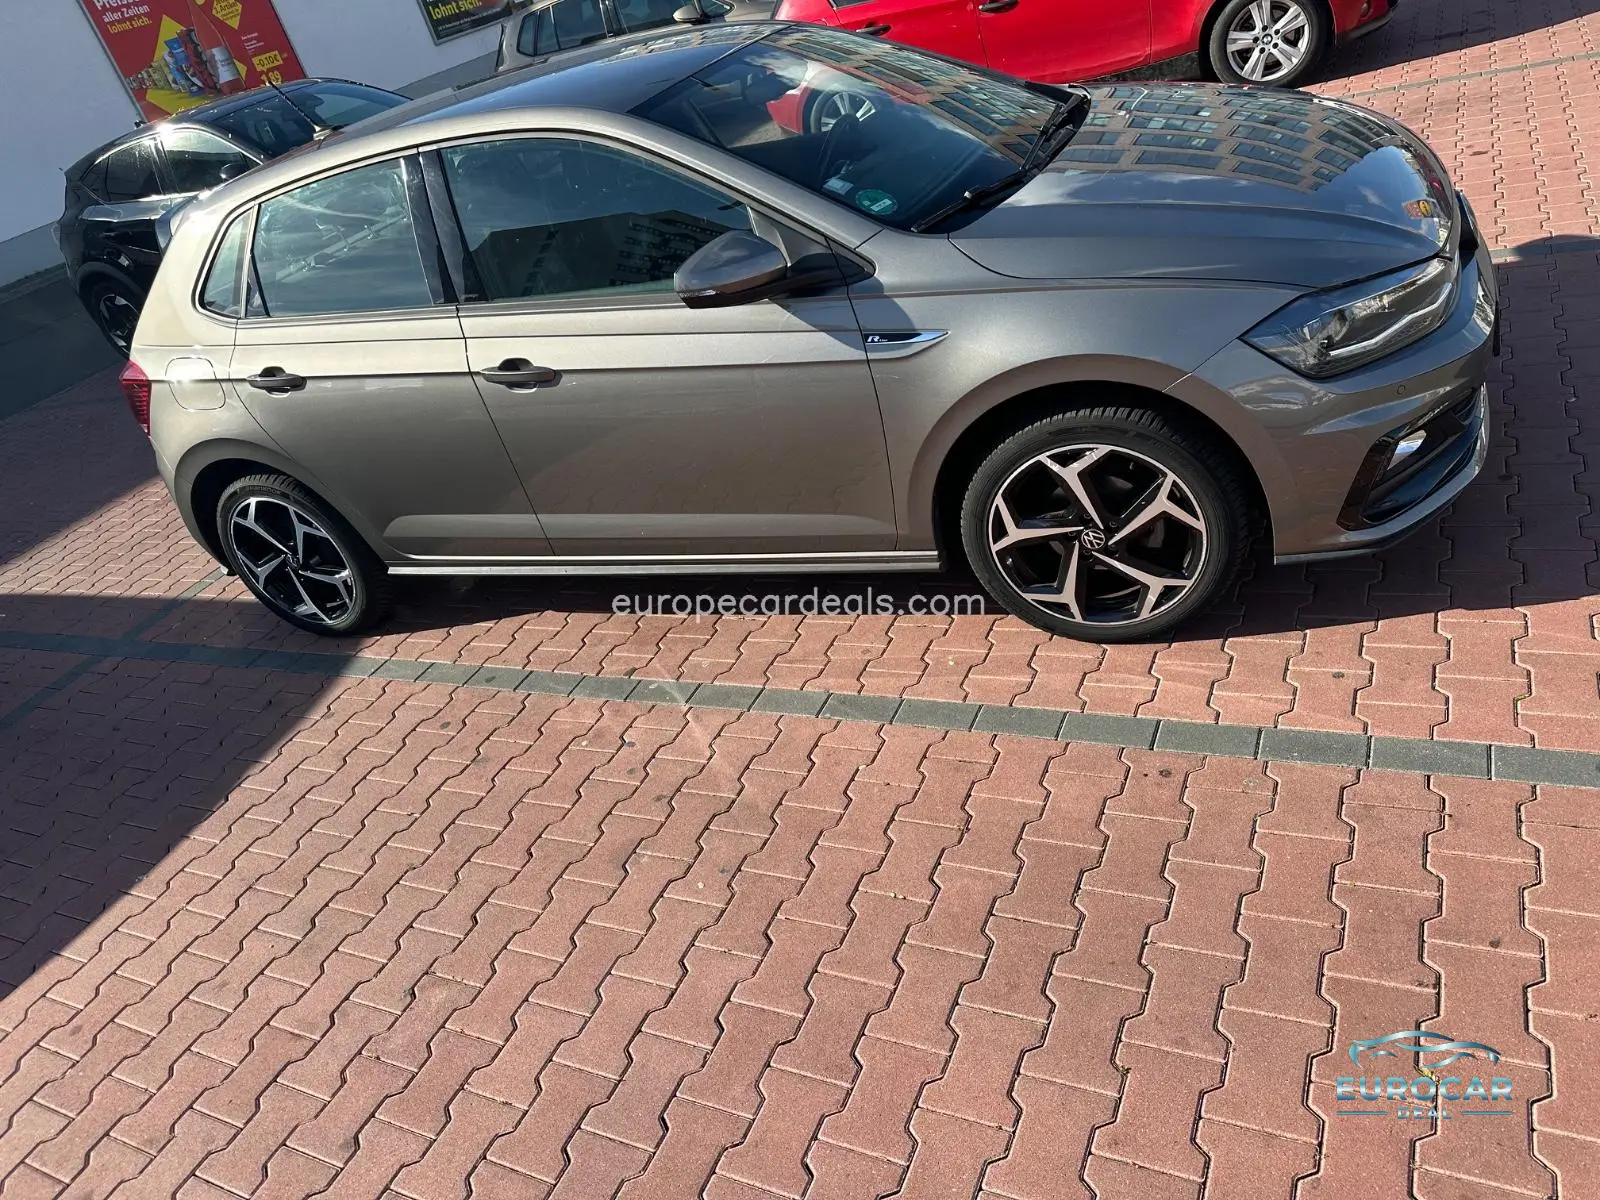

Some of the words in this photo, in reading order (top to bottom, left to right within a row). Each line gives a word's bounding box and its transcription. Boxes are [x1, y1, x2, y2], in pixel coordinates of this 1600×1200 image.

[102, 11, 122, 23] aller
[121, 4, 151, 18] Zeiten
[429, 1, 460, 20] lohnt
[107, 20, 133, 34] lohnt
[133, 15, 153, 28] sich.
